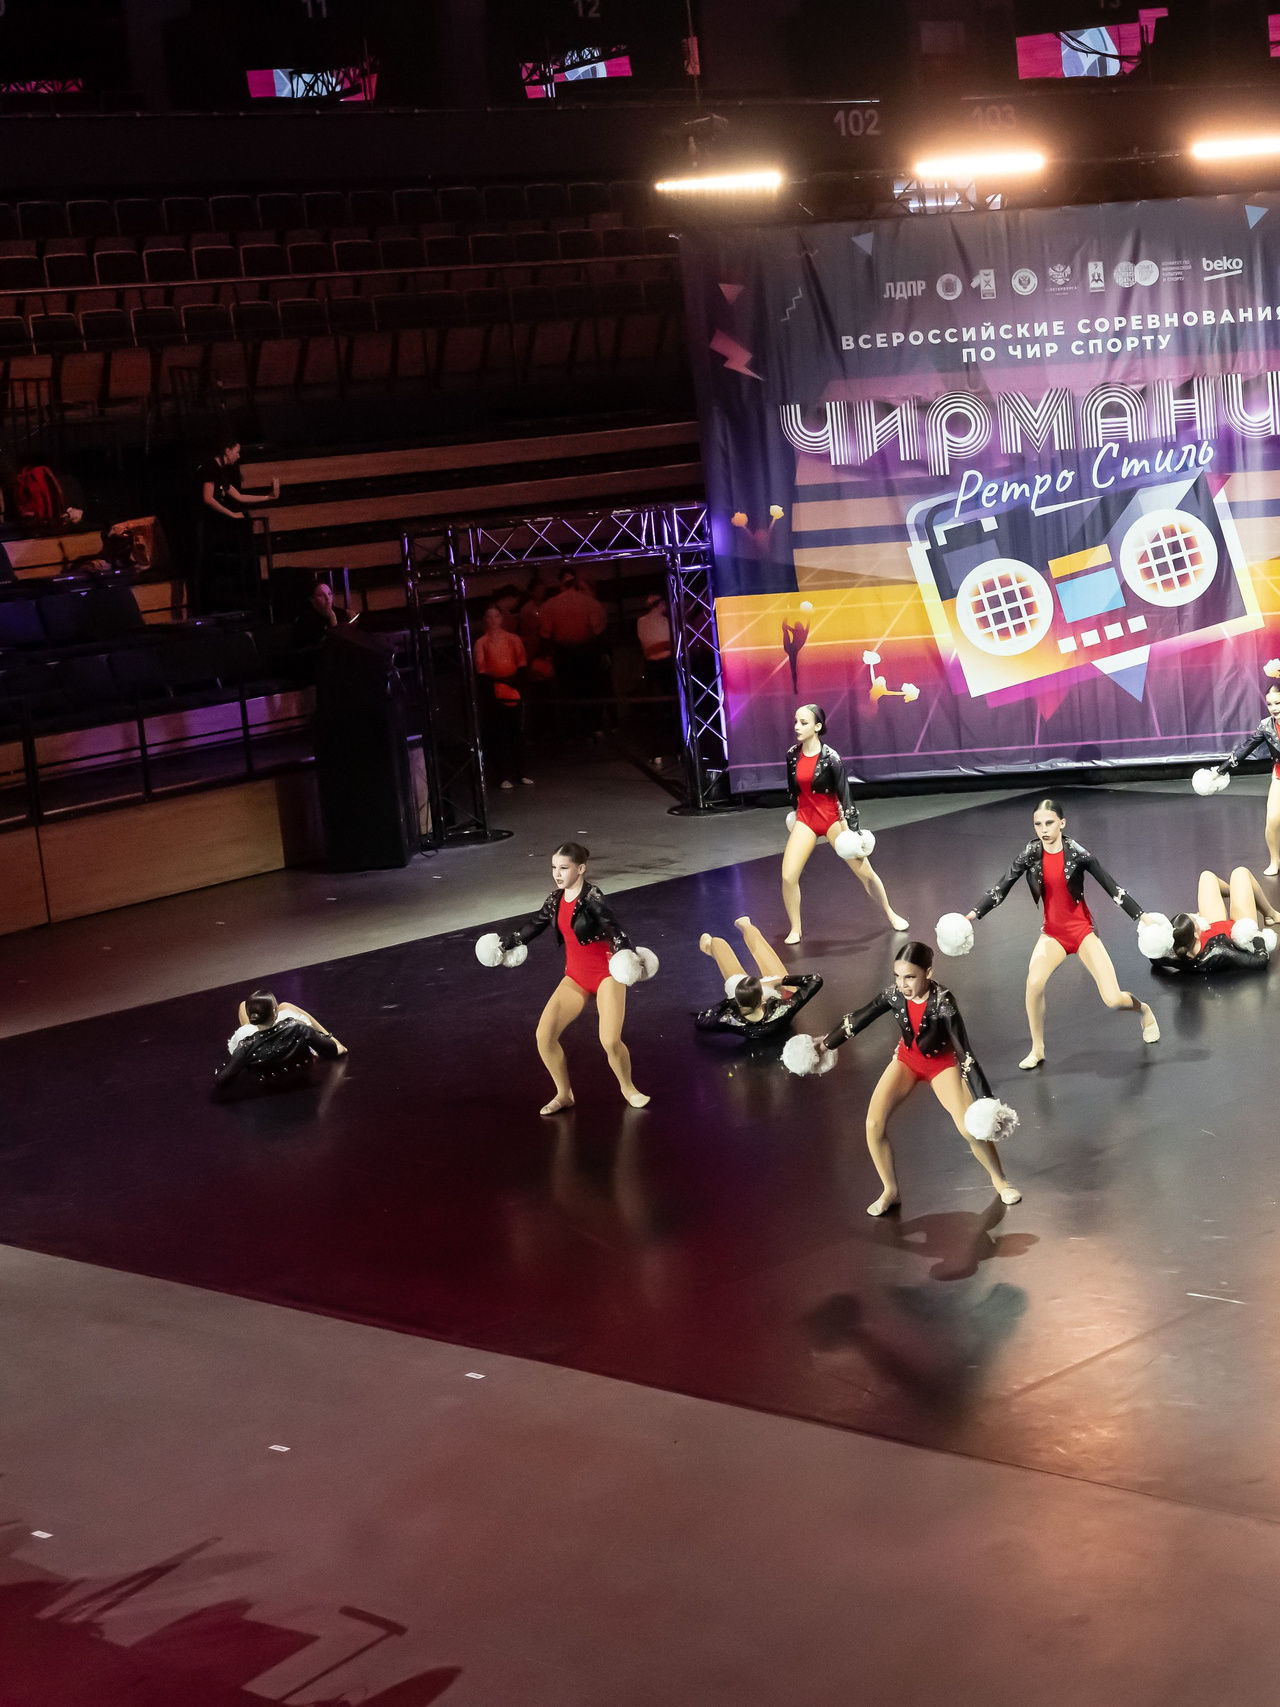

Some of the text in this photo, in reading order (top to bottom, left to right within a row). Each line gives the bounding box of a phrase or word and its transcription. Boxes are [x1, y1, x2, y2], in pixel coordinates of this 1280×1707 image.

[834, 109, 880, 136] 102
[1202, 256, 1243, 272] beko
[883, 280, 927, 300] ЛДПР
[841, 318, 1066, 351] ВСЕРОССИЙСКИЕ
[962, 334, 1173, 363] ПО ЧИР СПОРТУ
[954, 440, 1214, 518] Ретро Стиль
